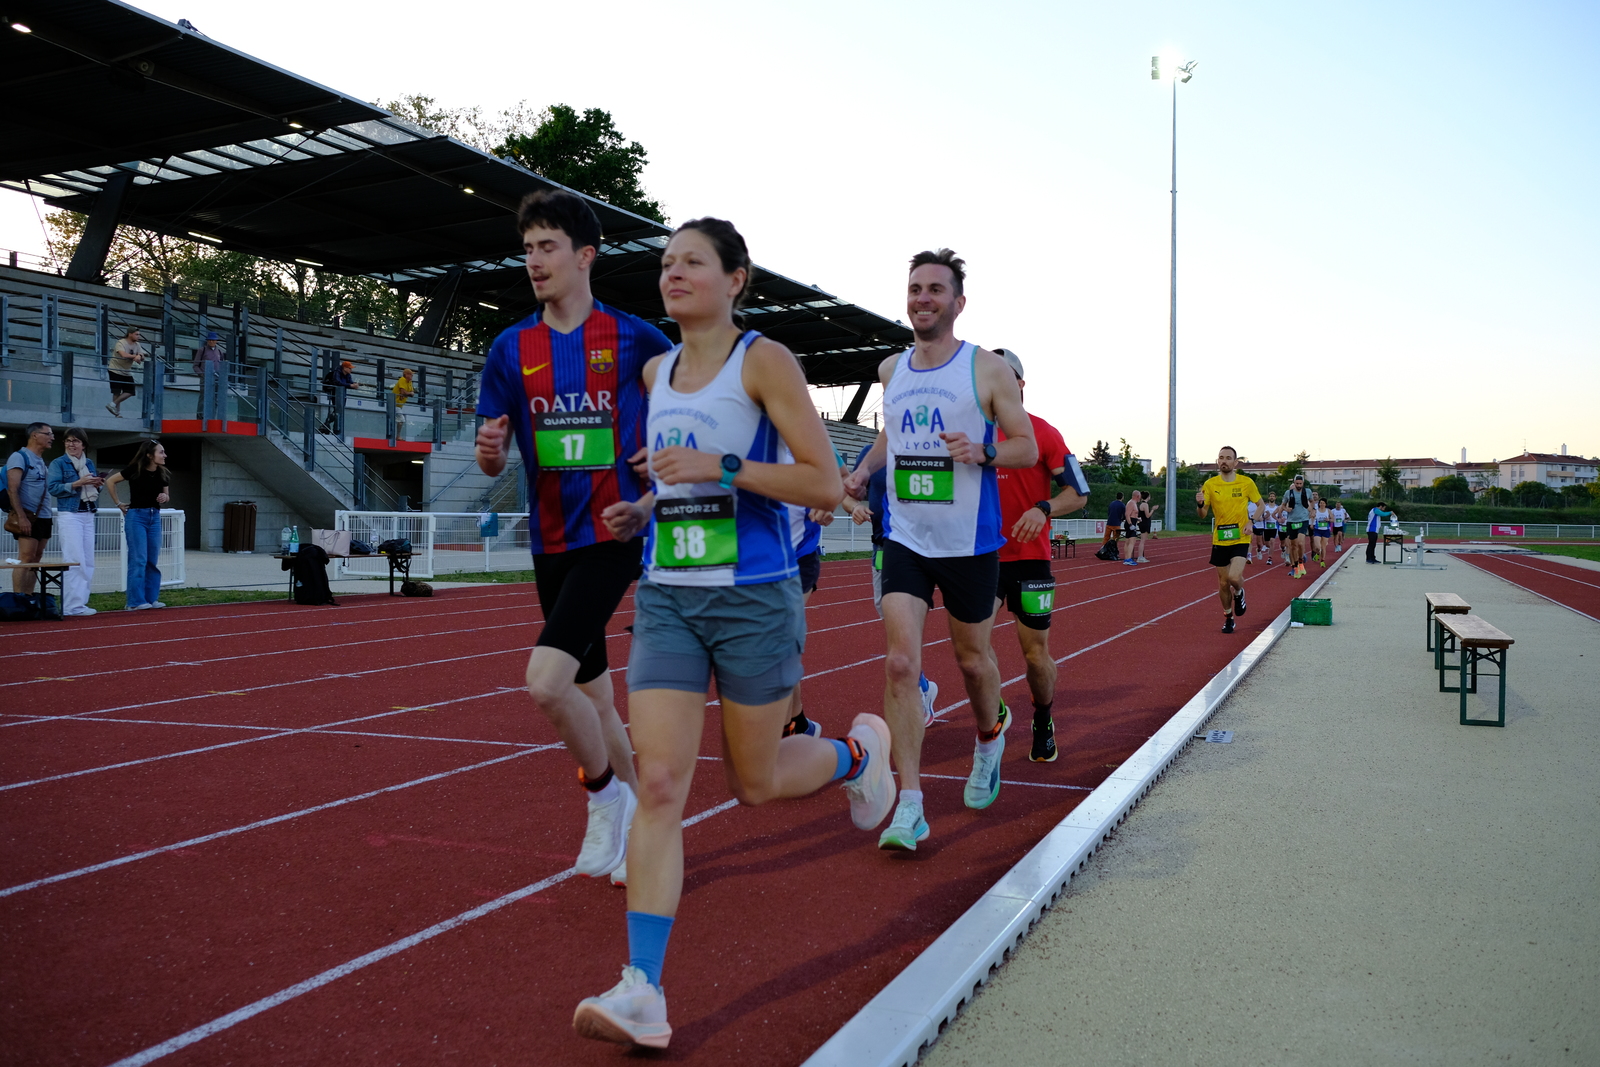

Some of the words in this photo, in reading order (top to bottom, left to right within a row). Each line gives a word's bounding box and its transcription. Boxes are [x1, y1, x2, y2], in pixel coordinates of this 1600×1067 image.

[530, 390, 613, 414] QATAR
[543, 416, 602, 426] QUATORZE
[560, 434, 585, 461] 17
[905, 440, 941, 450] LYON
[900, 460, 945, 468] QUATORZE
[909, 473, 934, 496] 65
[660, 503, 720, 516] QUATORZE
[1223, 530, 1233, 539] 25
[672, 525, 707, 560] 38
[1037, 593, 1052, 610] 14
